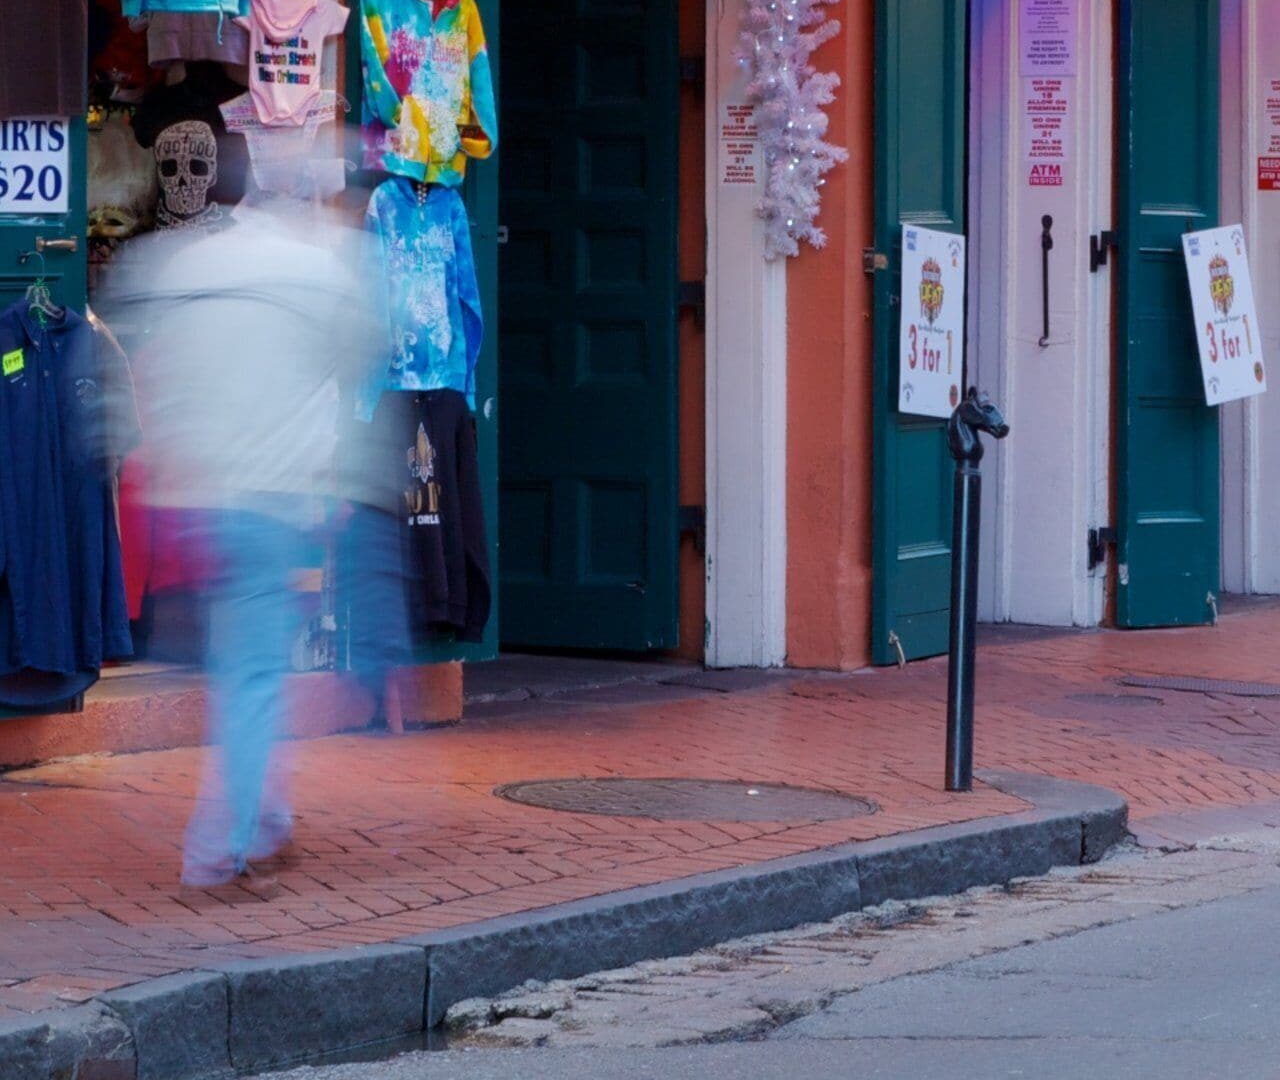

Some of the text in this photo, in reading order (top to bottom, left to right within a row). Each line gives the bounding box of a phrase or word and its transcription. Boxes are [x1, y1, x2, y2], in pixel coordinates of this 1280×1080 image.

[1031, 164, 1061, 176] ATM
[908, 323, 953, 375] 3 for 1
[1206, 315, 1253, 363] 3 for 1
